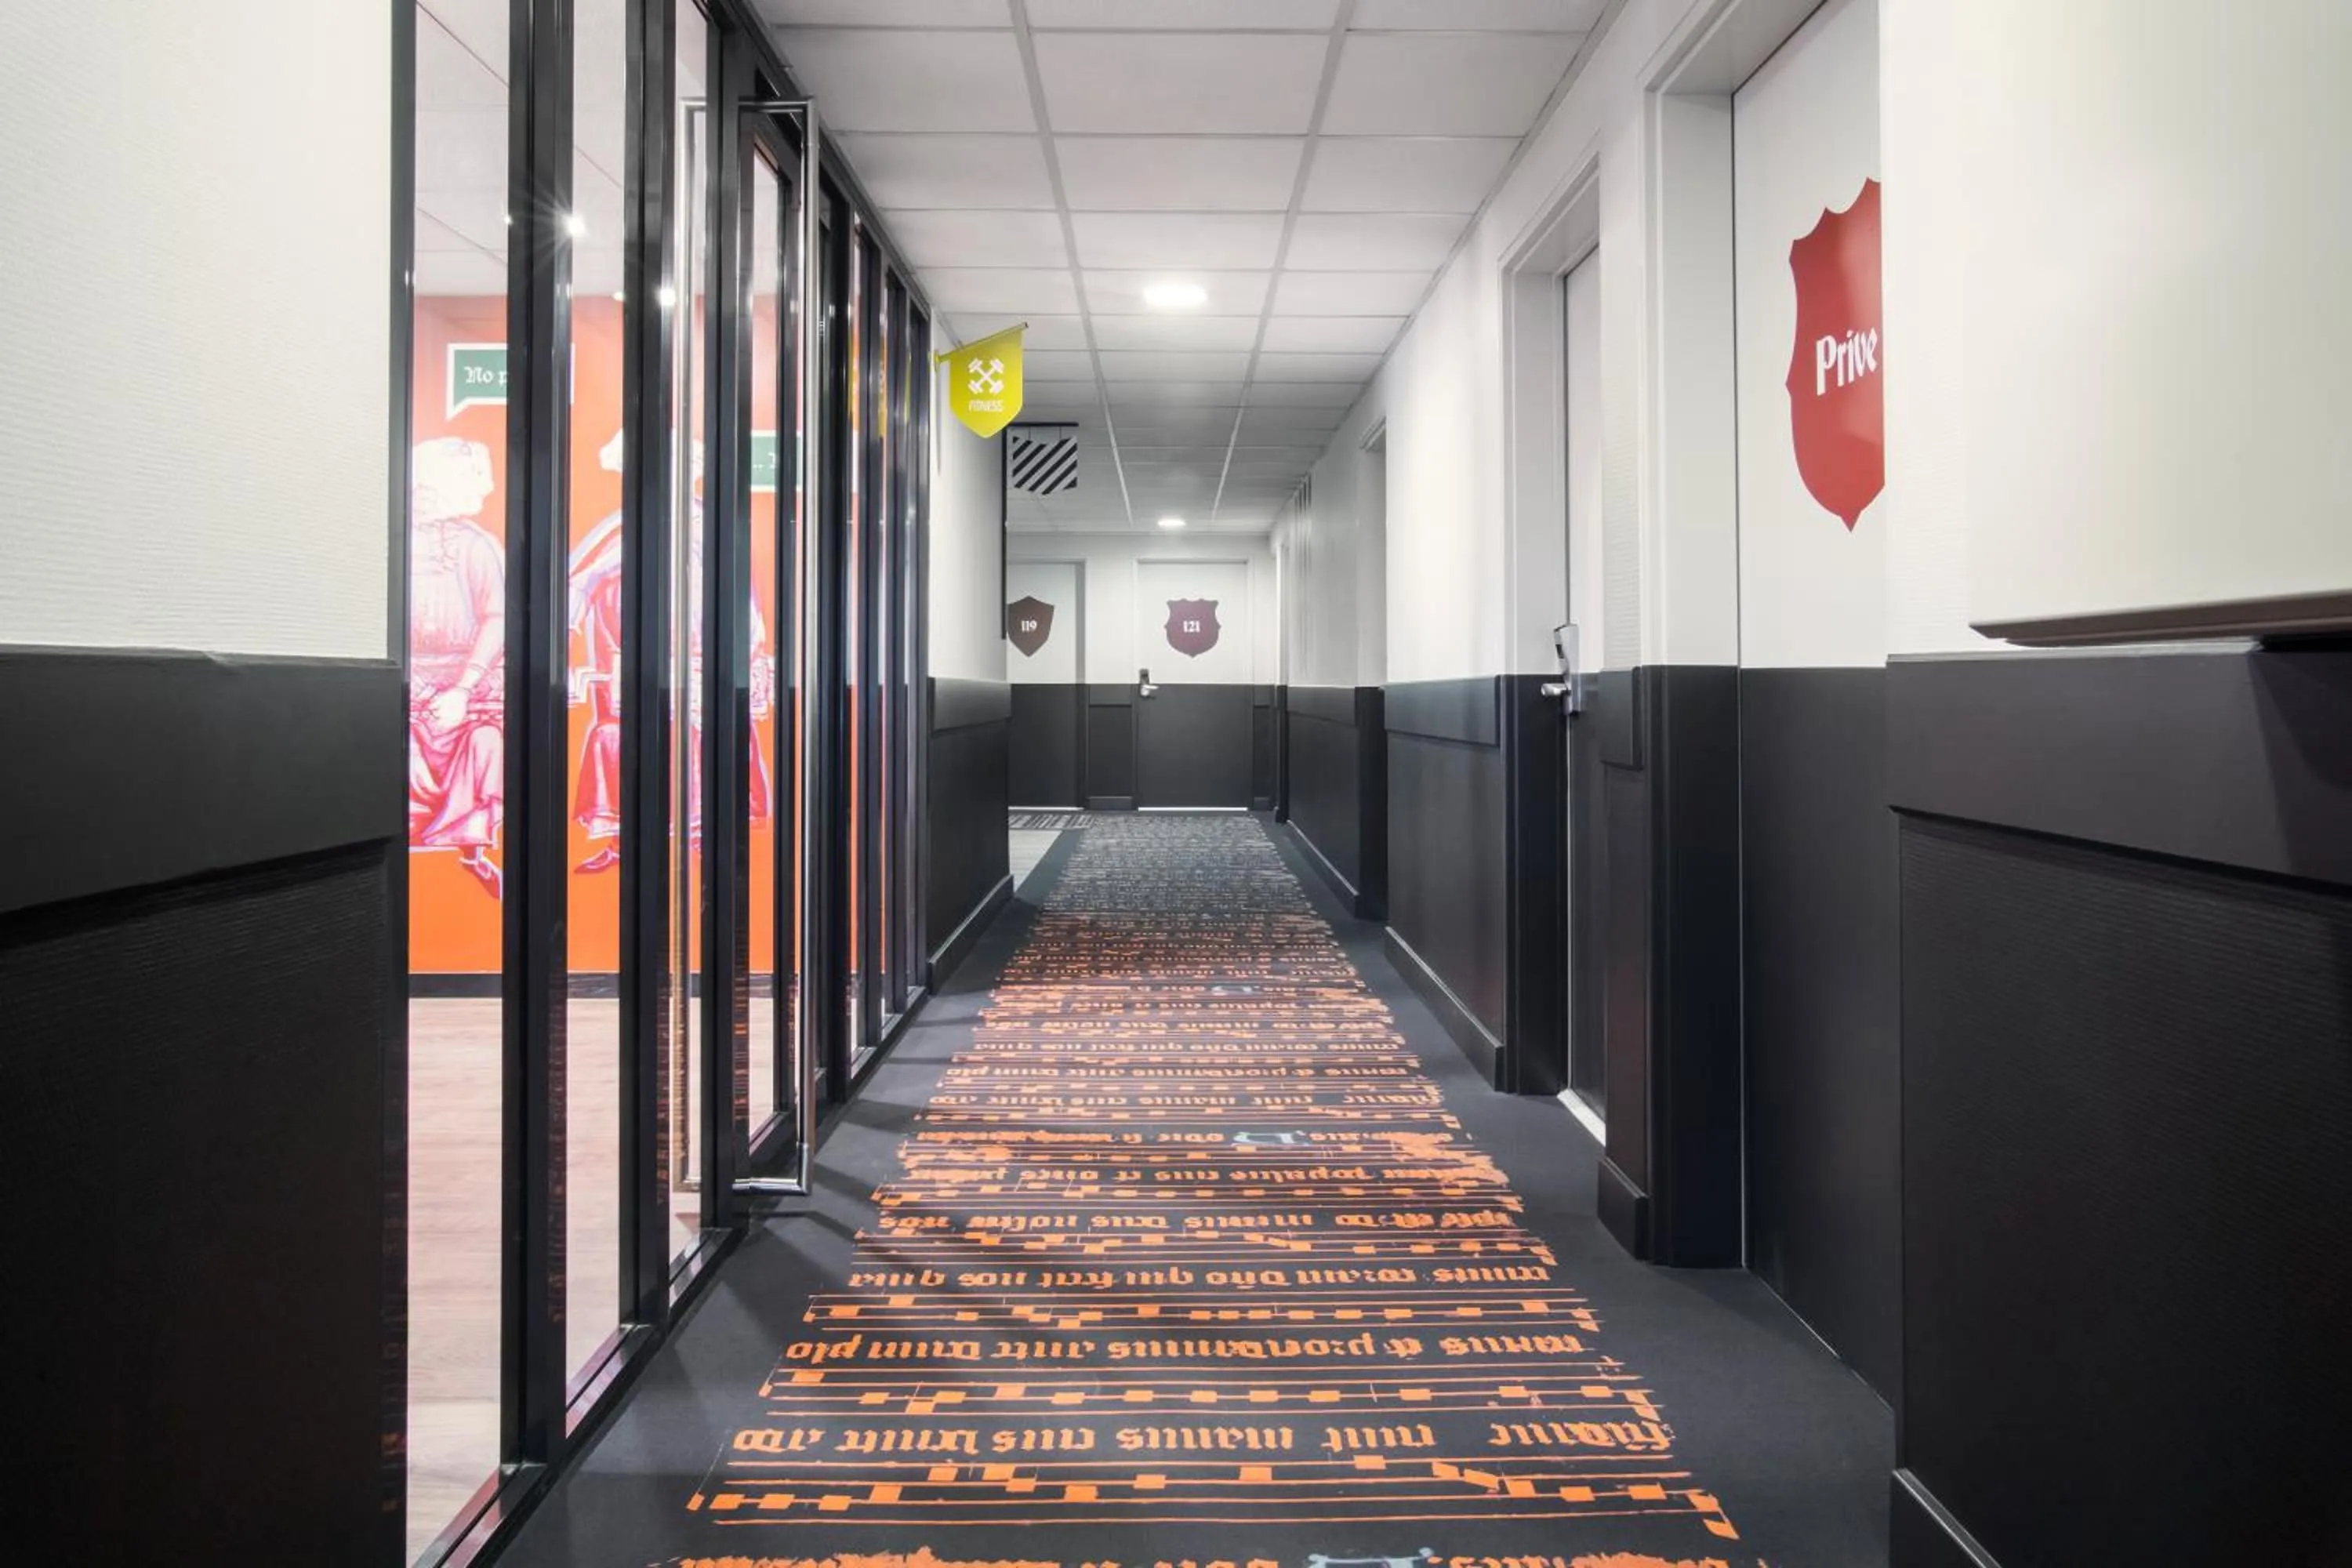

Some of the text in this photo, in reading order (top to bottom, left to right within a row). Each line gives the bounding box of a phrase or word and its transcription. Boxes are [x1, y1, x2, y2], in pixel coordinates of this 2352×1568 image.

[464, 366, 494, 384] No
[969, 400, 1004, 412] FITNESS
[1021, 619, 1038, 633] 119
[1183, 619, 1201, 633] 121
